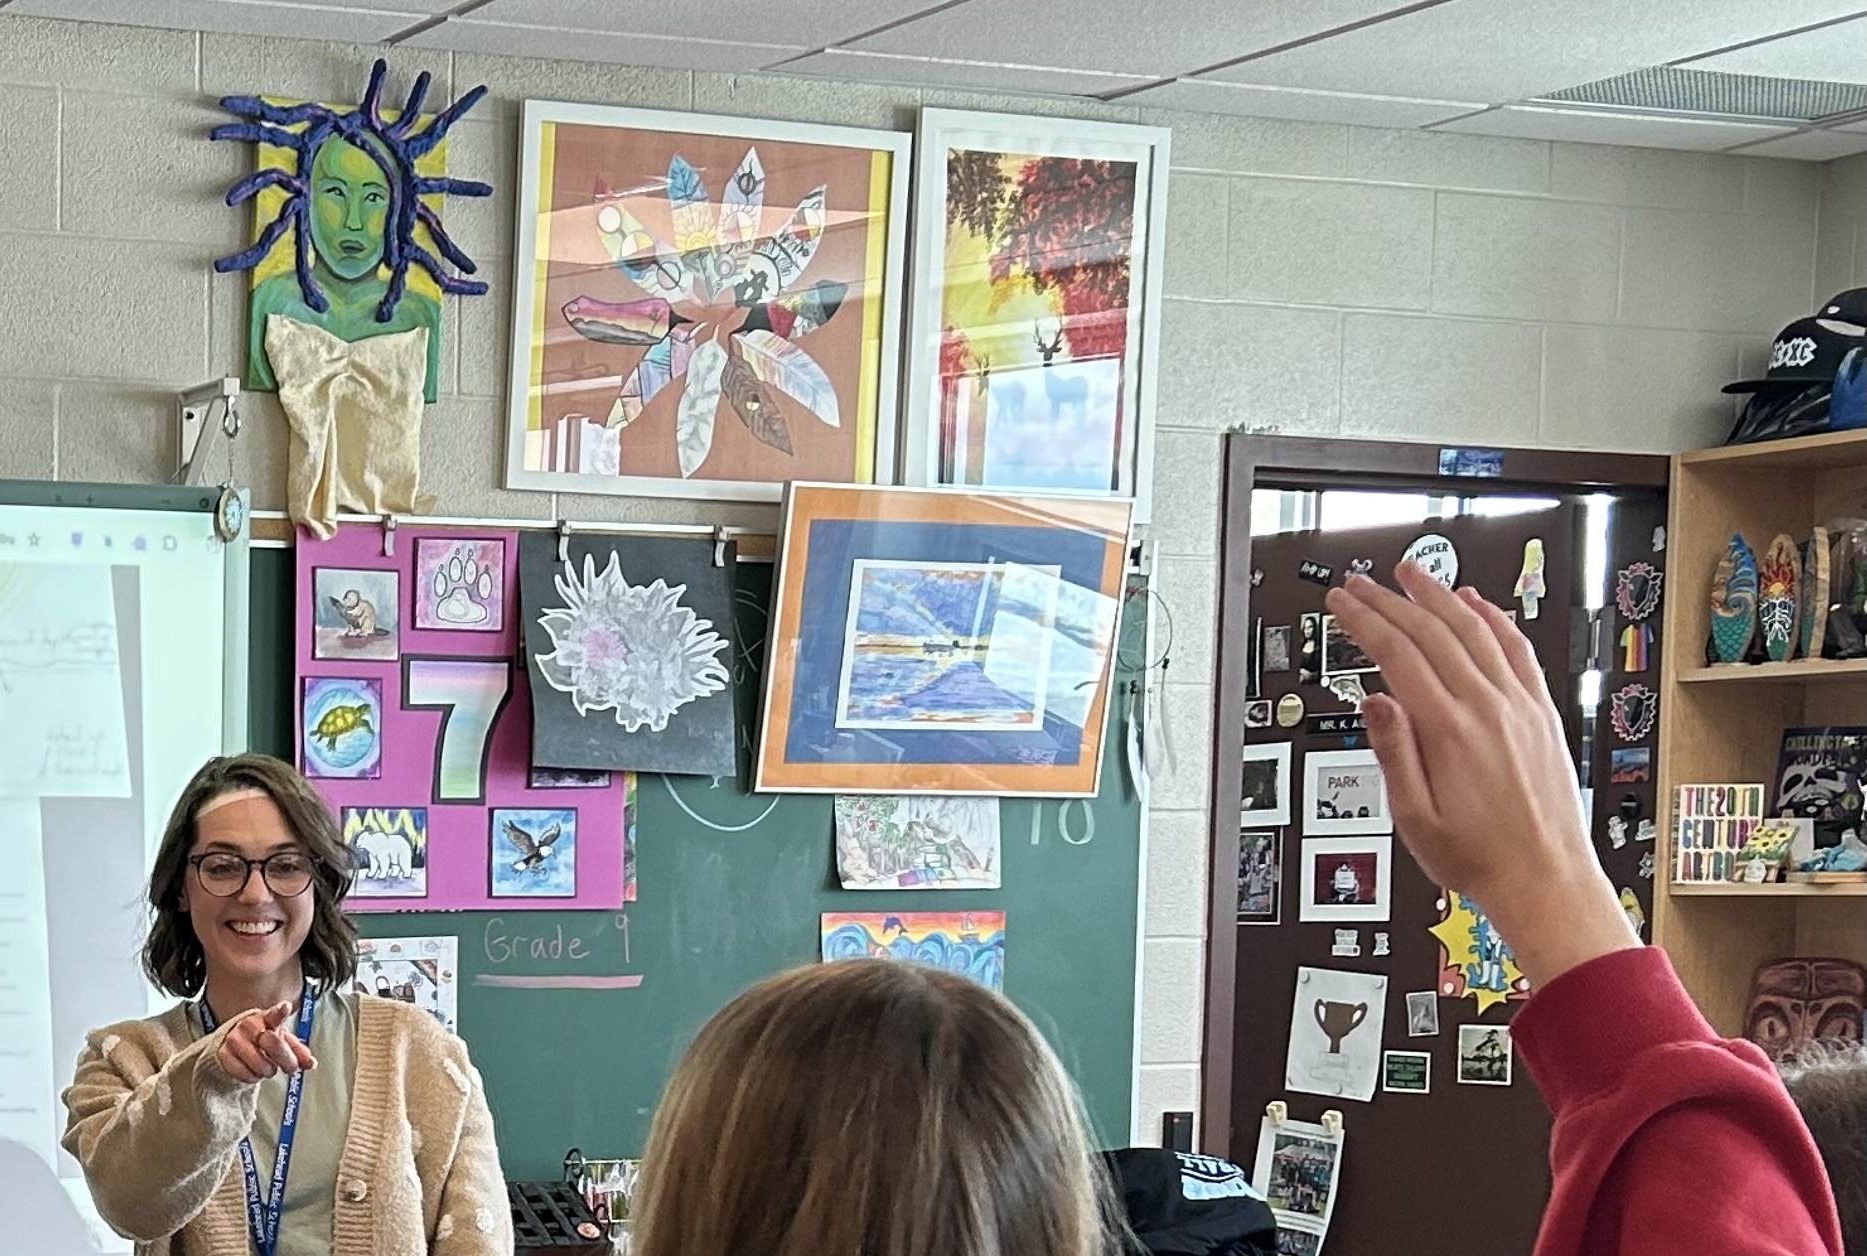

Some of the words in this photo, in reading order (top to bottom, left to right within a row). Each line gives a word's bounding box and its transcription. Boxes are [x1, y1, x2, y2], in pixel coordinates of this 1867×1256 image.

[1413, 542, 1449, 561] ACHER
[401, 653, 513, 806] 7
[1328, 775, 1360, 789] PARK
[484, 917, 590, 963] Grade
[615, 912, 631, 964] 9
